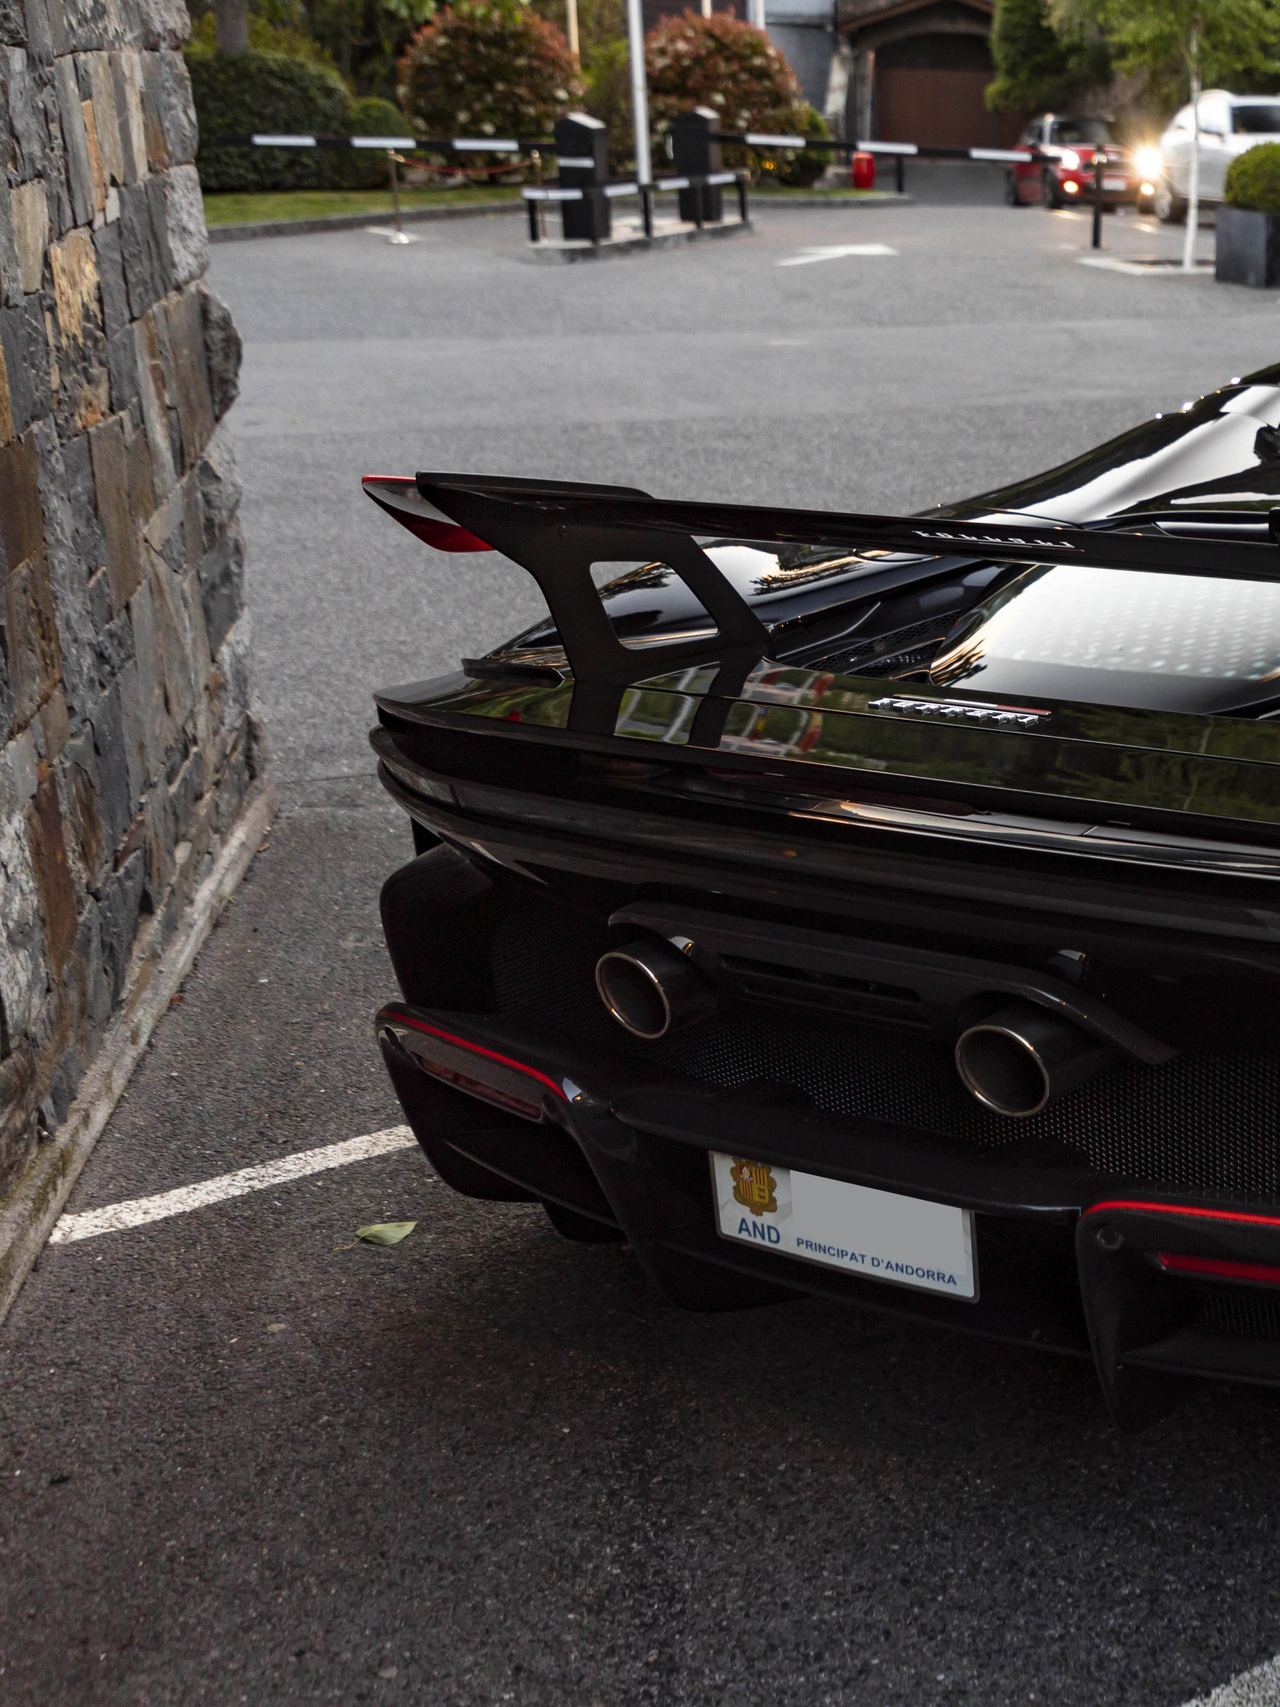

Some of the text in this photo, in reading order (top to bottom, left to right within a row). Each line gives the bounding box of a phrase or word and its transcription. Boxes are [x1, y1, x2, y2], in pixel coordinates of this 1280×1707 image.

[737, 1217, 781, 1245] AND
[796, 1237, 958, 1286] PRINCIPAT D'ANDORRA
